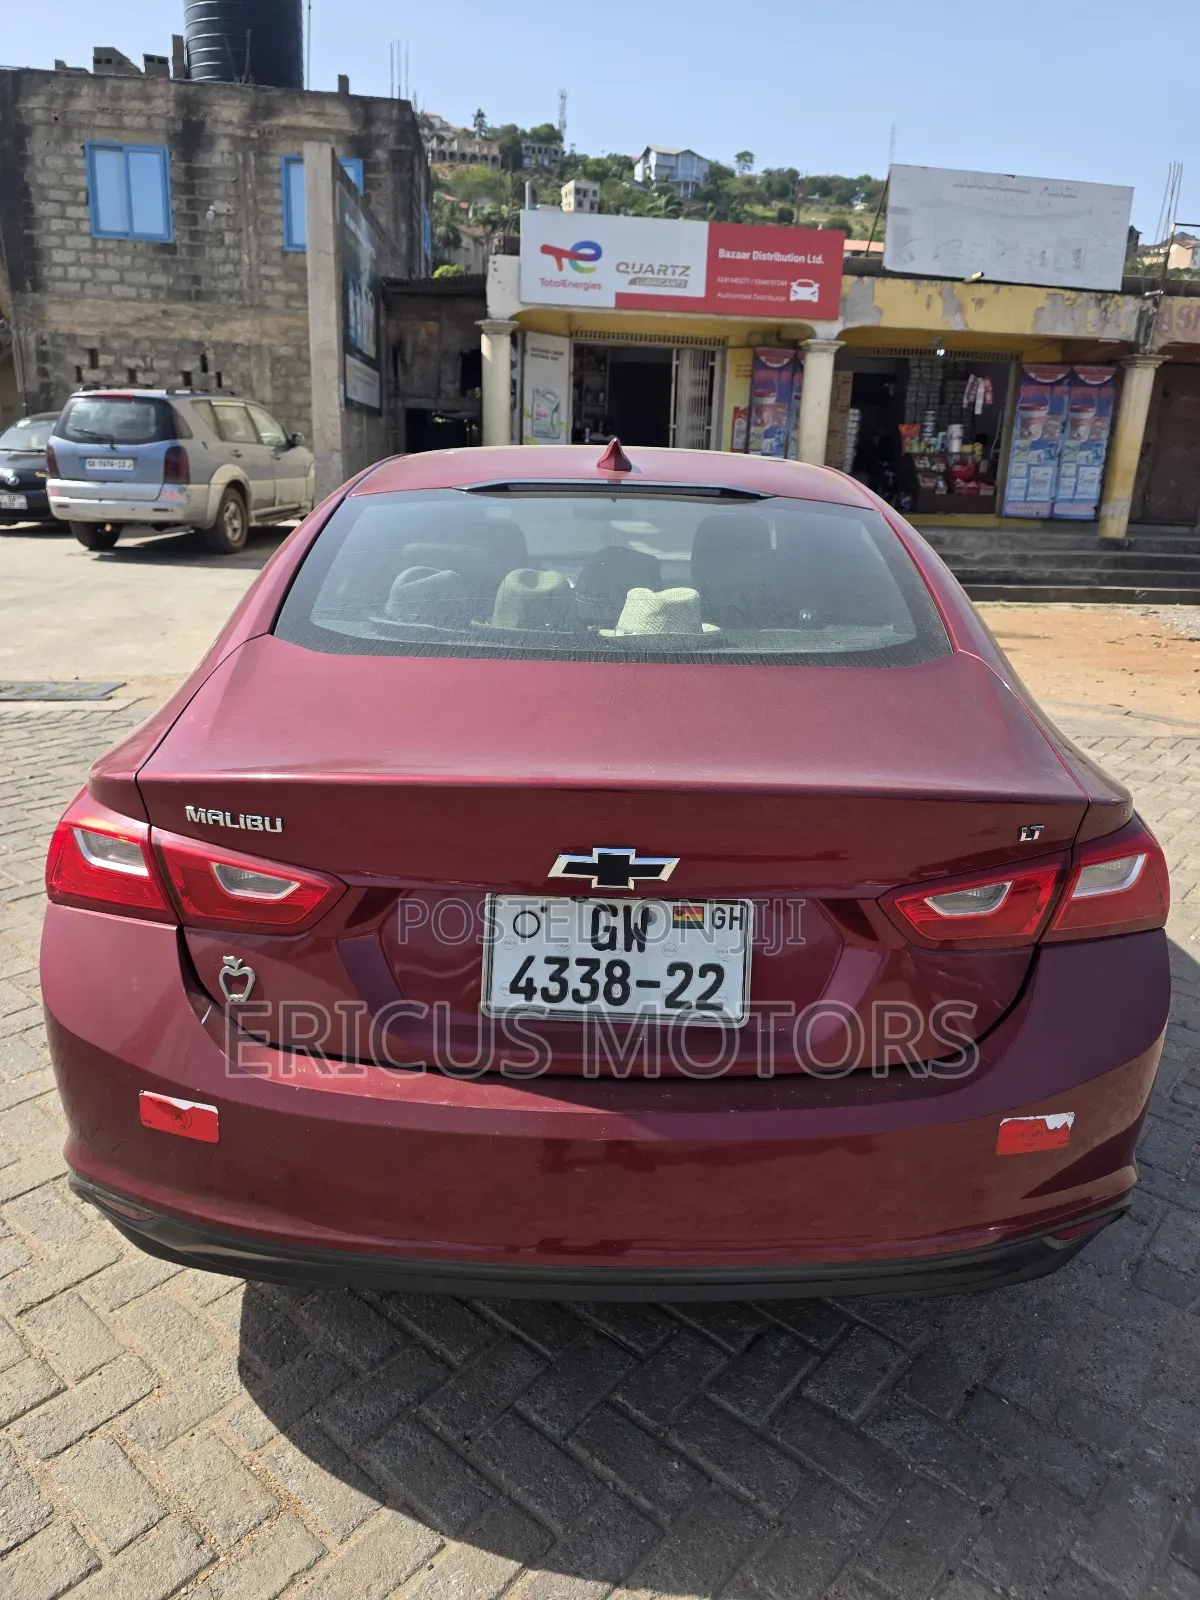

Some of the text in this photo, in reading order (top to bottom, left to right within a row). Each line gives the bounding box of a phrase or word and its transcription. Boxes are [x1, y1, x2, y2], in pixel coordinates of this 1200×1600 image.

[718, 248, 825, 264] Bazaar Distribution Ltd.
[615, 261, 692, 277] QUARTZ
[538, 277, 602, 292] TotalEnergies
[185, 805, 283, 833] MALIBU
[1020, 825, 1045, 842] LT
[590, 904, 650, 953] GW
[712, 906, 743, 931] GH
[509, 955, 725, 1011] 4338-22
